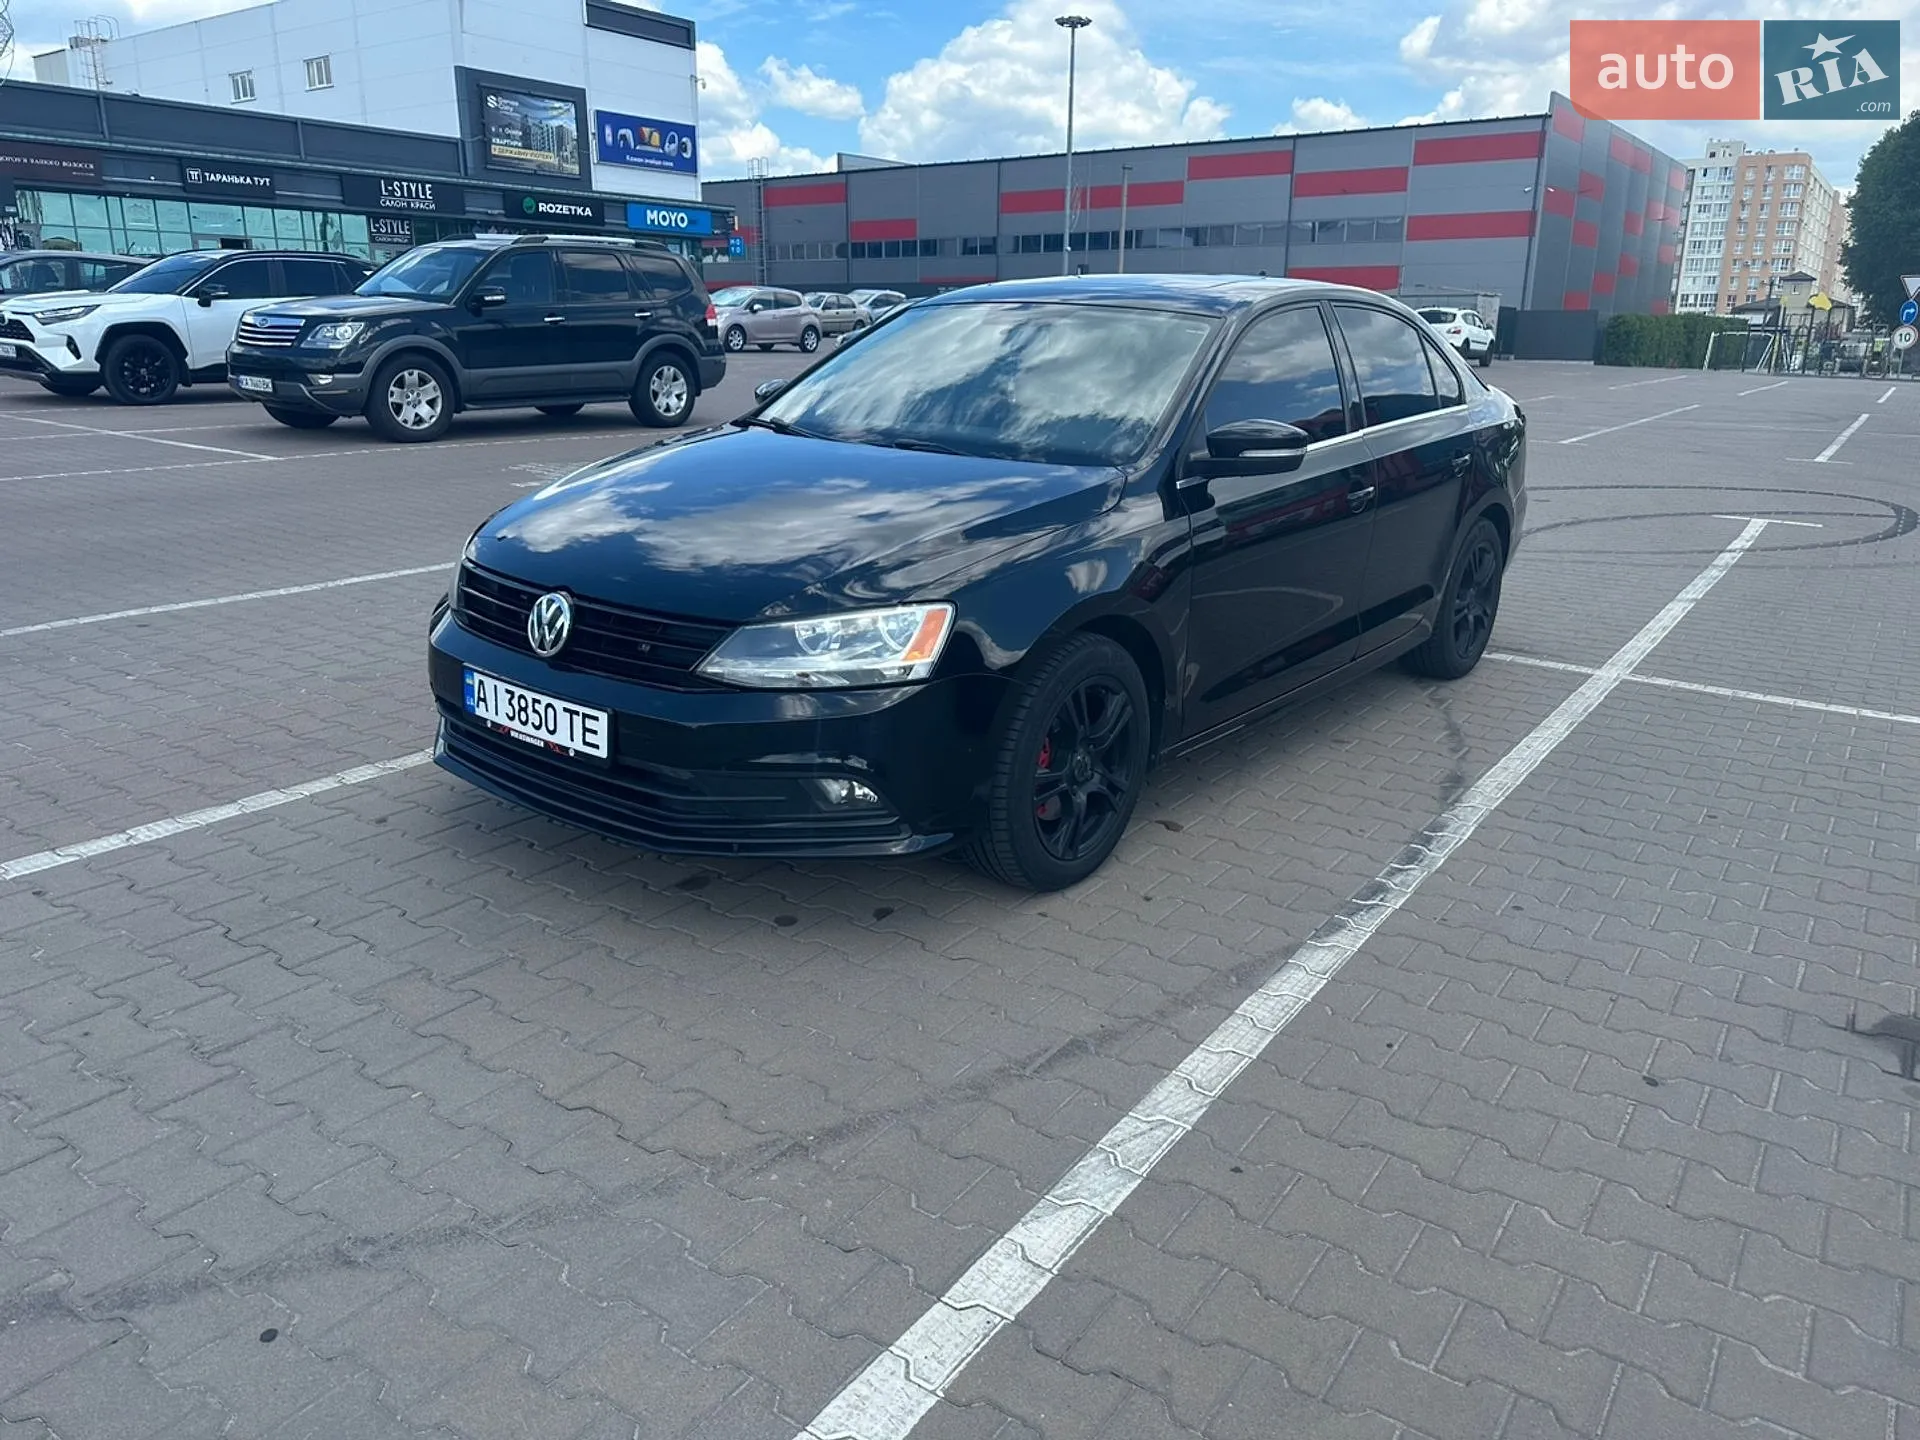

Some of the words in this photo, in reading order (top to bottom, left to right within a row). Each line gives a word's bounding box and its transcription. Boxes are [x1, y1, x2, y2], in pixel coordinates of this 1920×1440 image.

[204, 171, 253, 185] ТАРАНЬКА
[253, 176, 271, 186] ТУТ
[380, 179, 434, 200] L-STYLE
[380, 199, 408, 208] САЛОН
[410, 201, 436, 211] КРАСИ
[538, 202, 593, 217] ROZETKA
[370, 217, 411, 235] L-STYLE
[646, 209, 688, 228] MOYO
[1899, 332, 1911, 343] 10
[476, 678, 499, 716] AI
[504, 687, 558, 736] 3850
[562, 706, 600, 750] TE
